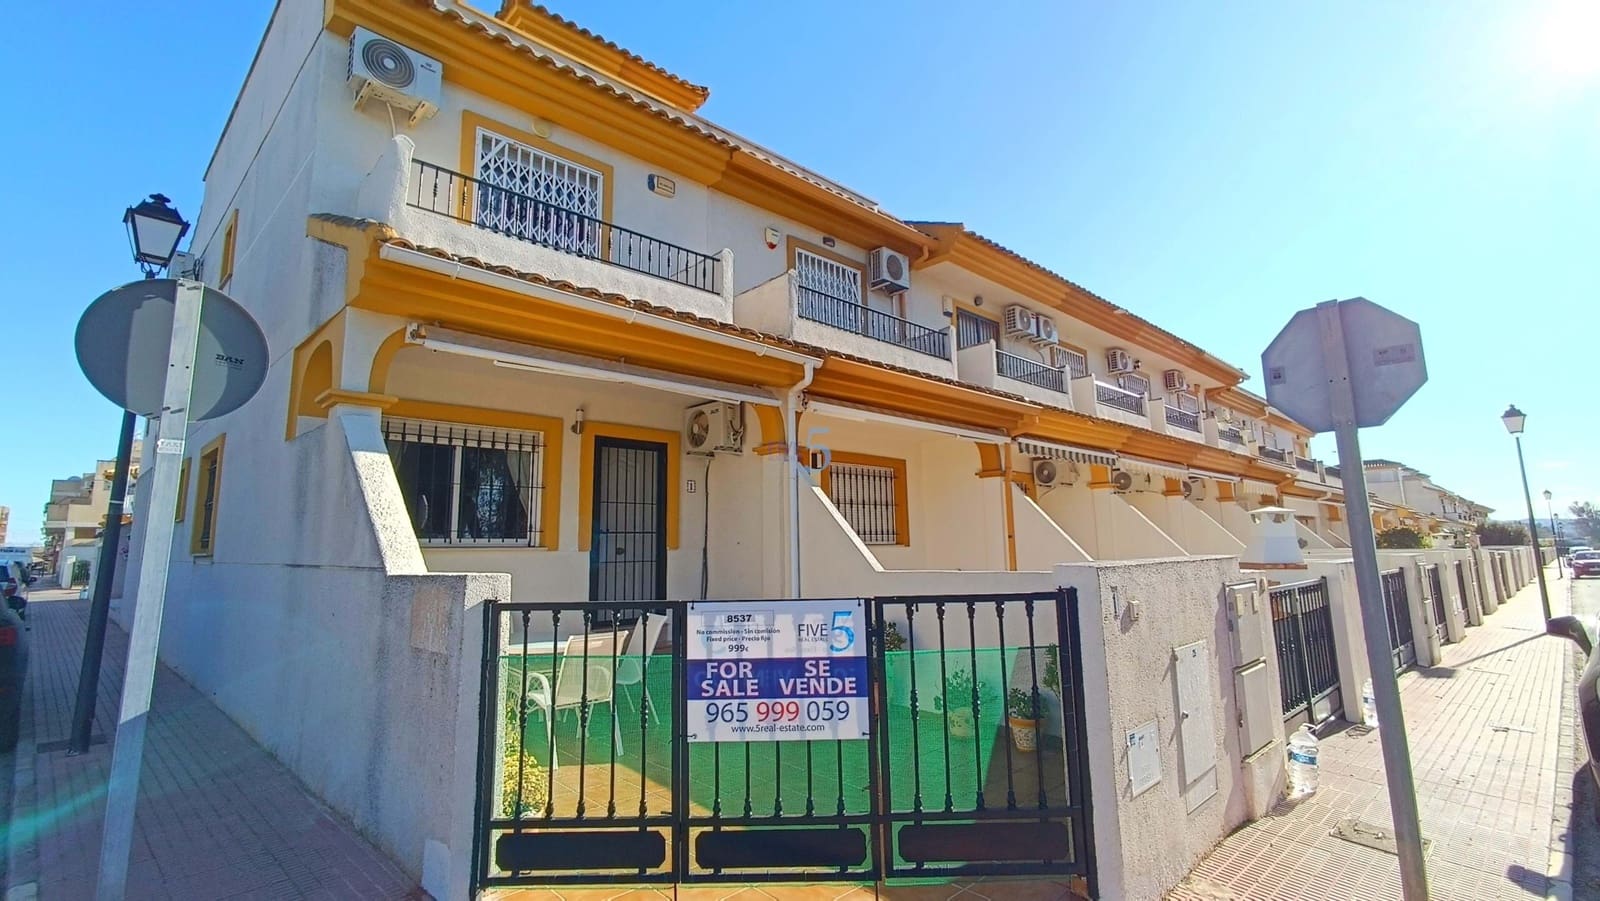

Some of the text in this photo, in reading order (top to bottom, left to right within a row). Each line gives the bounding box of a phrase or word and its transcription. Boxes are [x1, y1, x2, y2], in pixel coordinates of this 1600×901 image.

[727, 614, 752, 623] 8537
[798, 611, 855, 652] FIVE 5
[706, 662, 753, 679] FOR
[804, 660, 831, 677] SE
[701, 679, 759, 697] SALE
[779, 677, 857, 696] VENDE
[706, 700, 850, 723] 965 999 059
[731, 724, 825, 733] www.5real-estate.com
